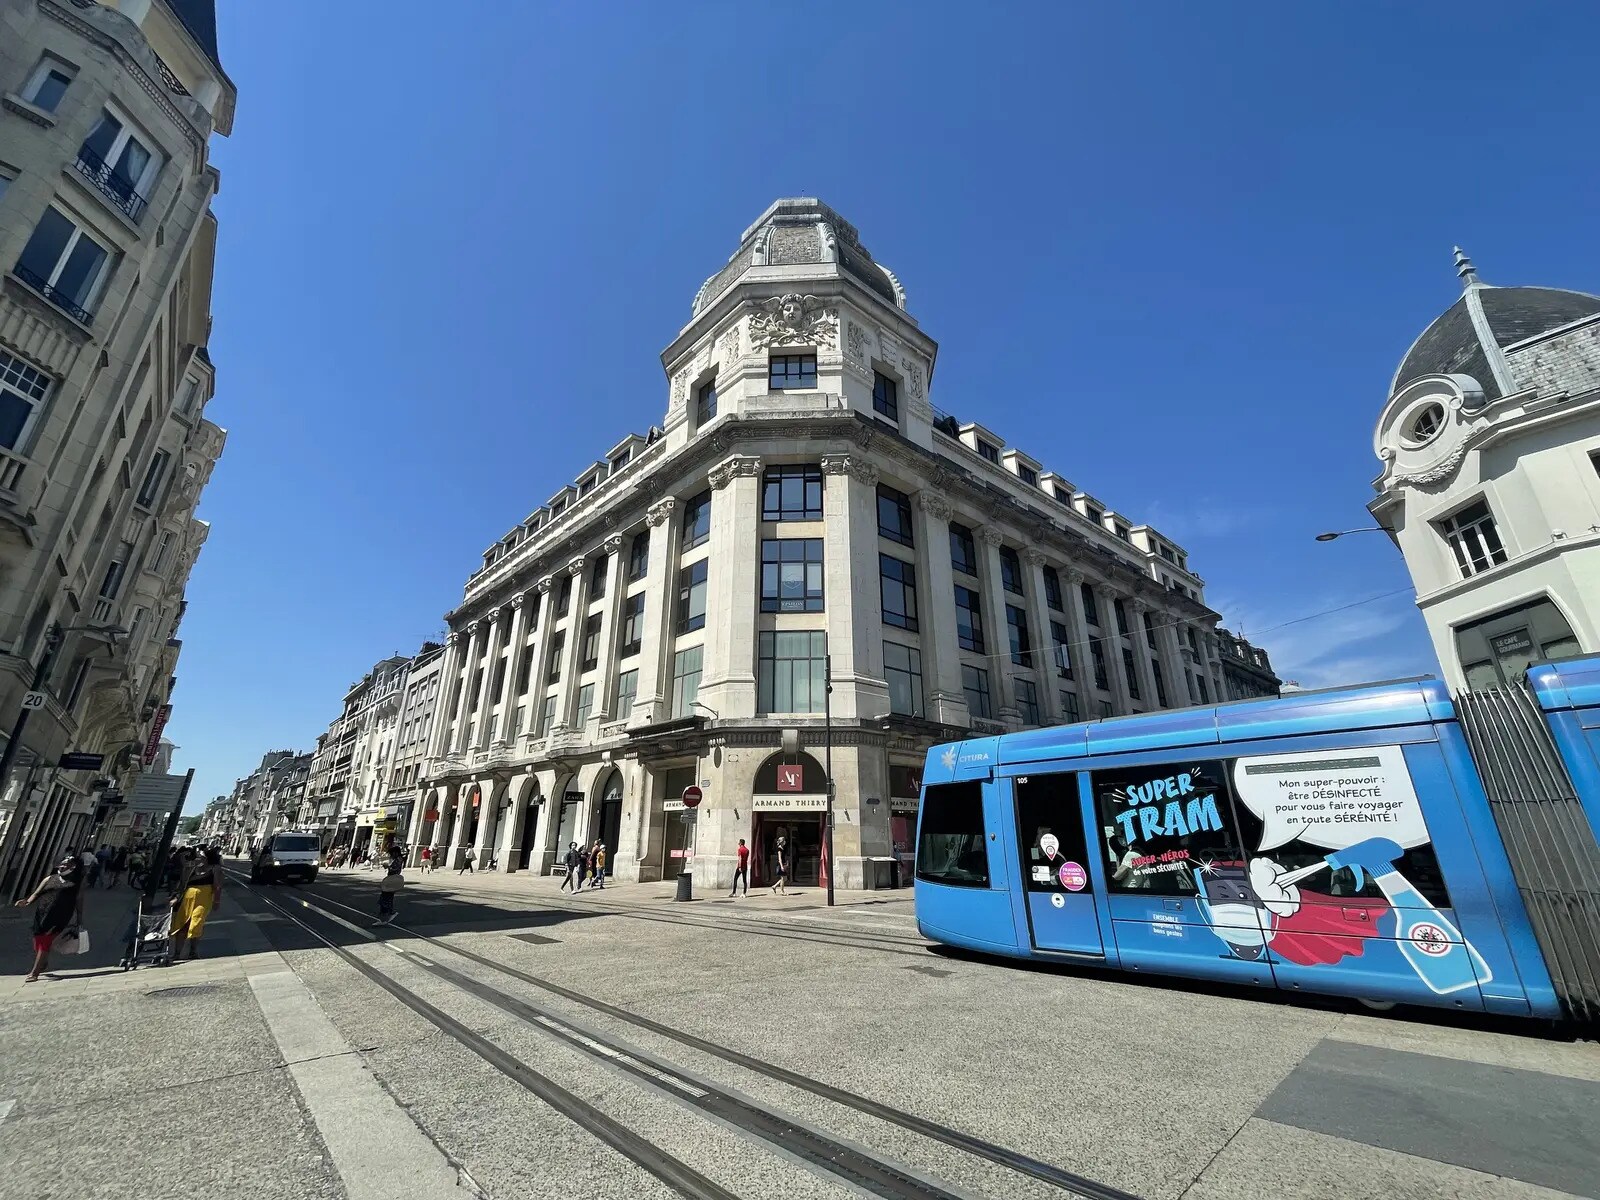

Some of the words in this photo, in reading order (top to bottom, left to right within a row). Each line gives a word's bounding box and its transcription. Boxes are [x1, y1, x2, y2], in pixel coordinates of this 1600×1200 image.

[24, 694, 43, 707] 20
[960, 753, 989, 763] CITURA
[1017, 777, 1028, 785] 105
[1279, 780, 1300, 788] Mon
[1303, 775, 1379, 789] super-pouvoir
[1126, 773, 1195, 806] SUPER
[1288, 791, 1309, 800] être
[1312, 787, 1381, 799] DÉSINFECTÉ
[1275, 803, 1299, 814] pour
[1300, 802, 1326, 811] vous
[1329, 801, 1354, 810] faire
[1357, 801, 1403, 811] voyager
[1115, 793, 1223, 845] TRAM
[1286, 816, 1299, 824] en
[1301, 815, 1332, 824] toute
[1334, 810, 1391, 823] SÉRÉNITÉ
[1394, 813, 1398, 822] !
[1133, 868, 1141, 876] de
[1141, 867, 1157, 875] votre
[1156, 861, 1184, 873] SÉCURITÉ
[1153, 914, 1178, 922] ENSEMBLE
